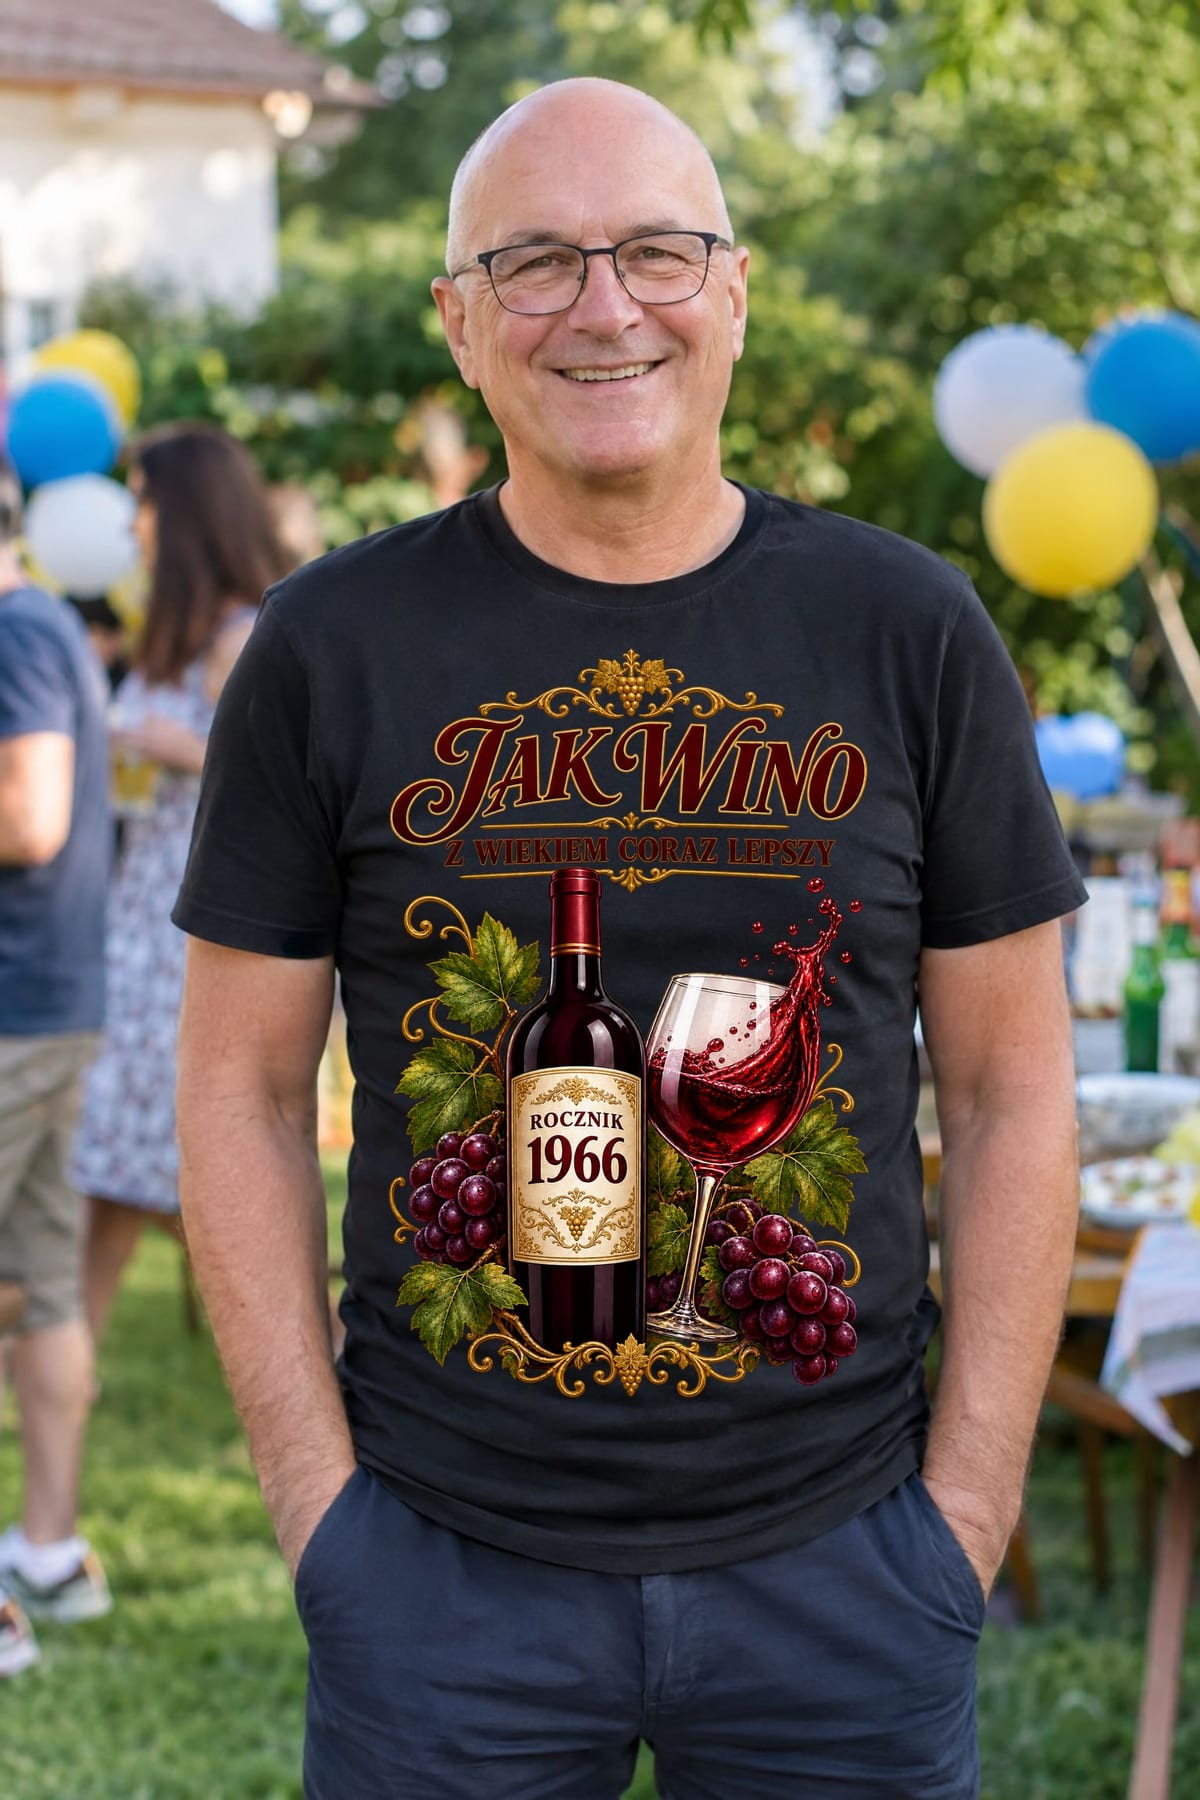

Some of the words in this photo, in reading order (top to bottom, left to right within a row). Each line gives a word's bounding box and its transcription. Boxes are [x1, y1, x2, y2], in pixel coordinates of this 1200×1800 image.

[390, 715, 622, 846] JAK
[613, 717, 868, 821] WINO
[443, 839, 464, 867] Z
[474, 837, 609, 866] WIEKIEM
[618, 836, 718, 865] CORAZ
[728, 838, 837, 867] LEPSZY
[530, 1111, 624, 1130] ROCZNIK
[527, 1135, 628, 1185] 1966
